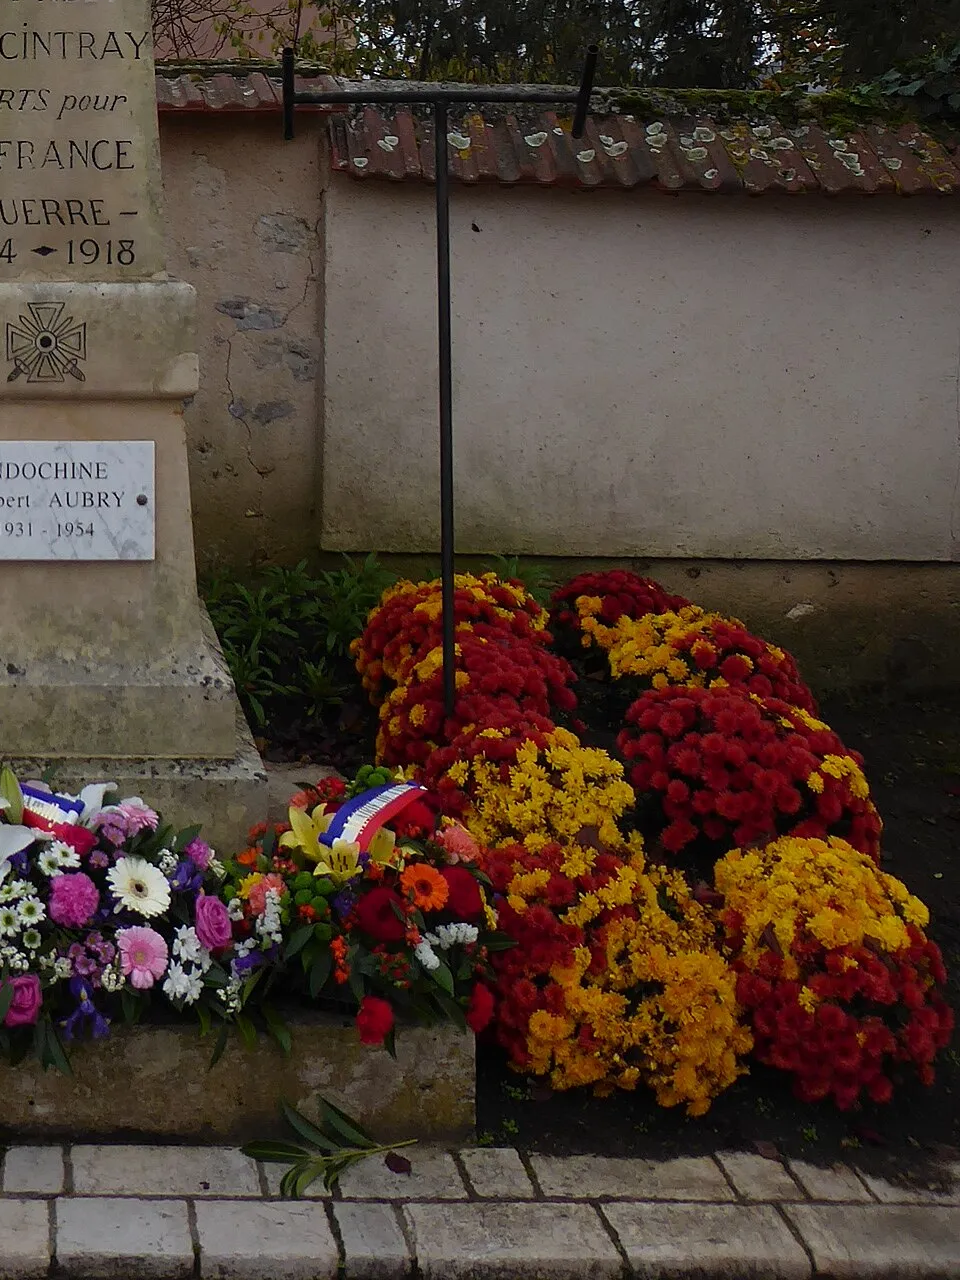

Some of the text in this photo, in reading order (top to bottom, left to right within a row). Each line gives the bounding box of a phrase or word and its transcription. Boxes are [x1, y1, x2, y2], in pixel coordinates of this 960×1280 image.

[56, 94, 127, 120] pour
[66, 239, 136, 266] 1918
[49, 491, 126, 508] AUBRY
[56, 522, 96, 537] 1954
